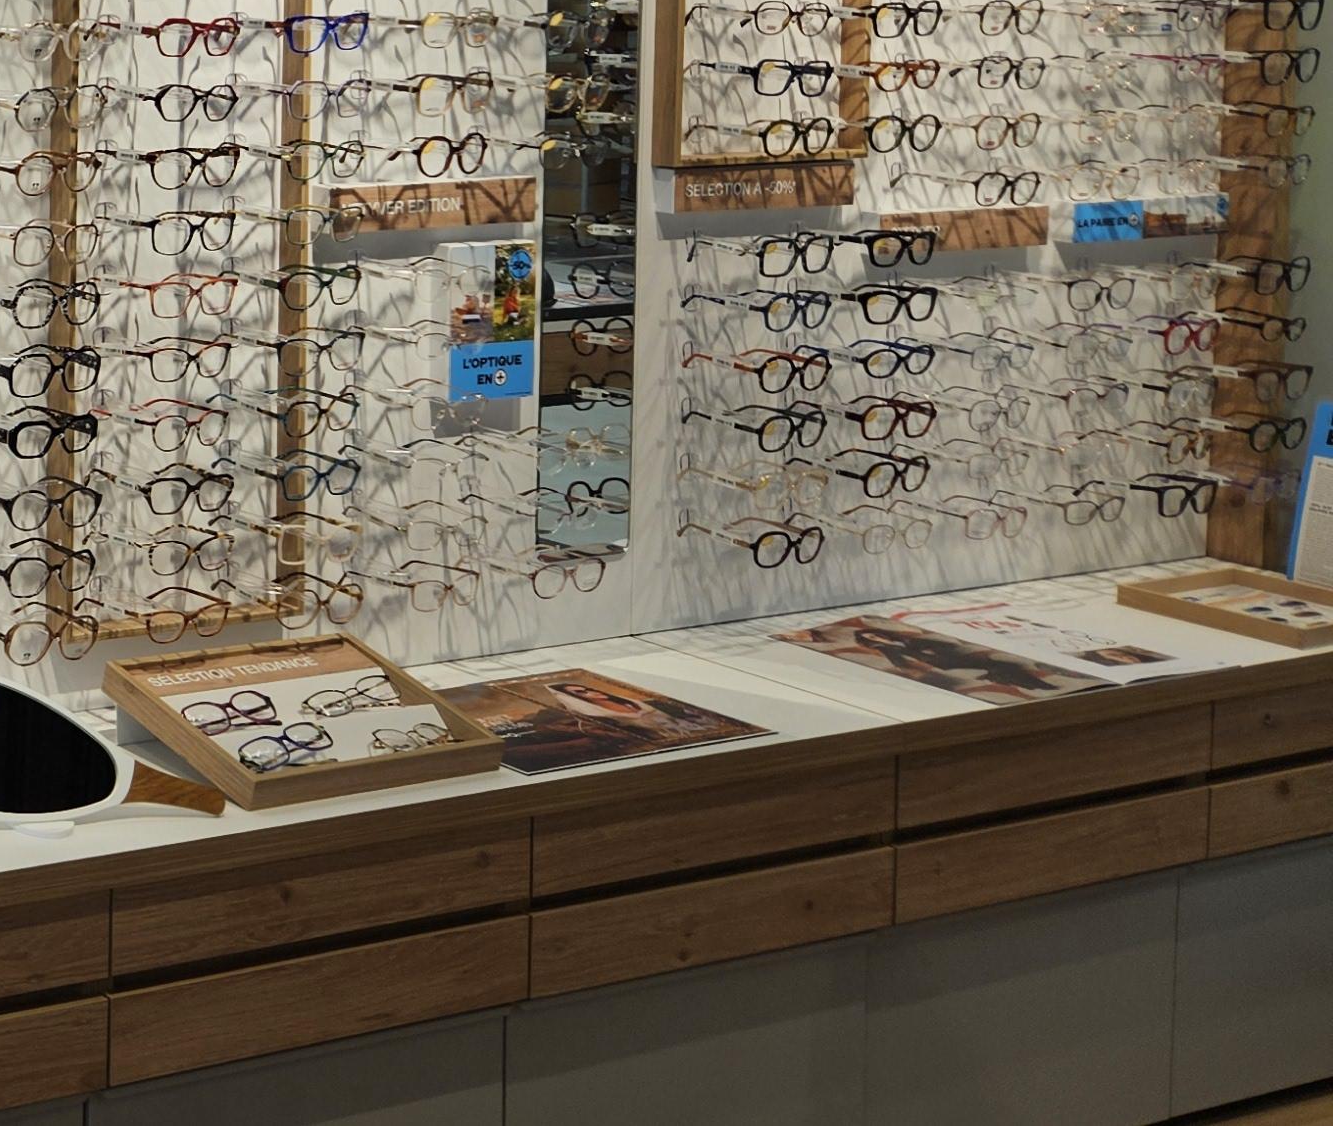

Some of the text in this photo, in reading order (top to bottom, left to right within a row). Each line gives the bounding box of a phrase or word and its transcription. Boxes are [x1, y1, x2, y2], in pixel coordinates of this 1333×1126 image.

[408, 197, 461, 214] EDITION
[462, 354, 523, 370] L'OPTIQUE
[477, 374, 493, 385] EN
[235, 656, 319, 677] TENDANCE
